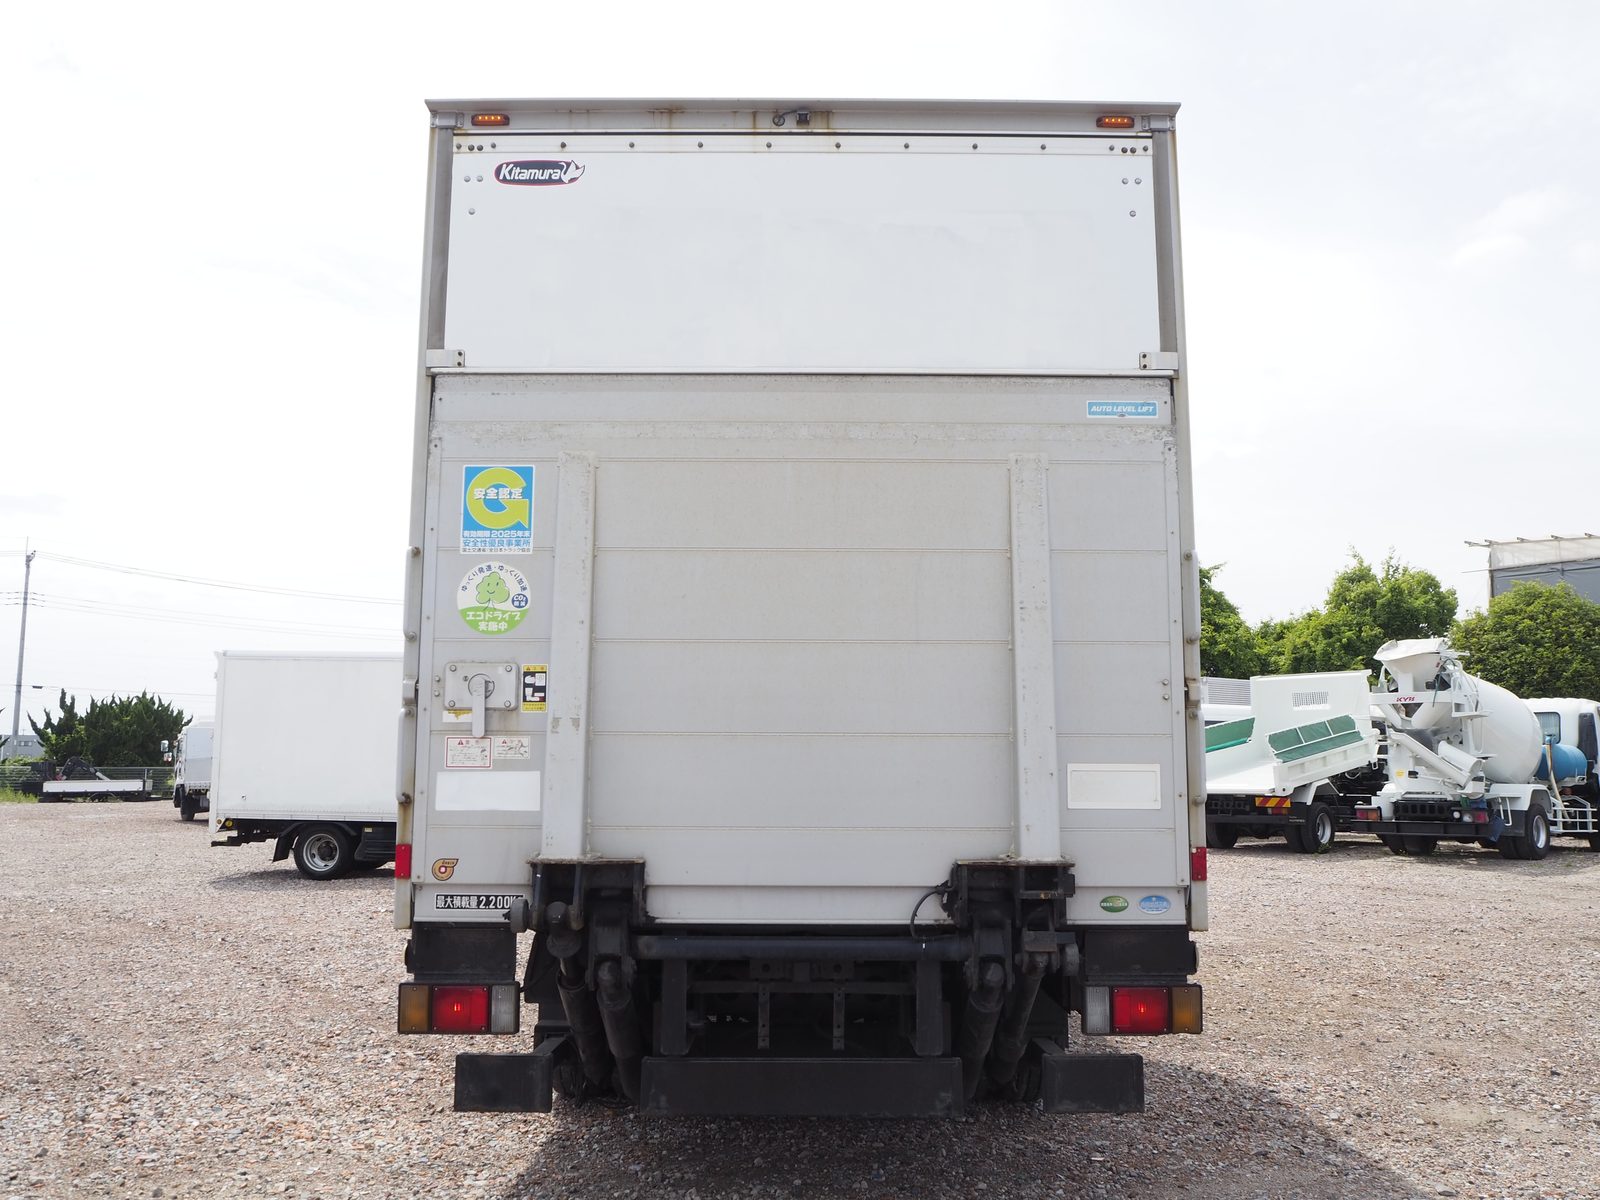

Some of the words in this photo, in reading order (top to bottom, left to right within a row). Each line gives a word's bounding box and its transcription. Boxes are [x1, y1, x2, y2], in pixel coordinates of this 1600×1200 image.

[499, 164, 561, 180] Kitamura
[473, 487, 523, 500] 安全認定
[463, 538, 531, 547] 安全性優良事業所
[466, 611, 521, 620] エコドライブ
[478, 621, 508, 631] 実施中
